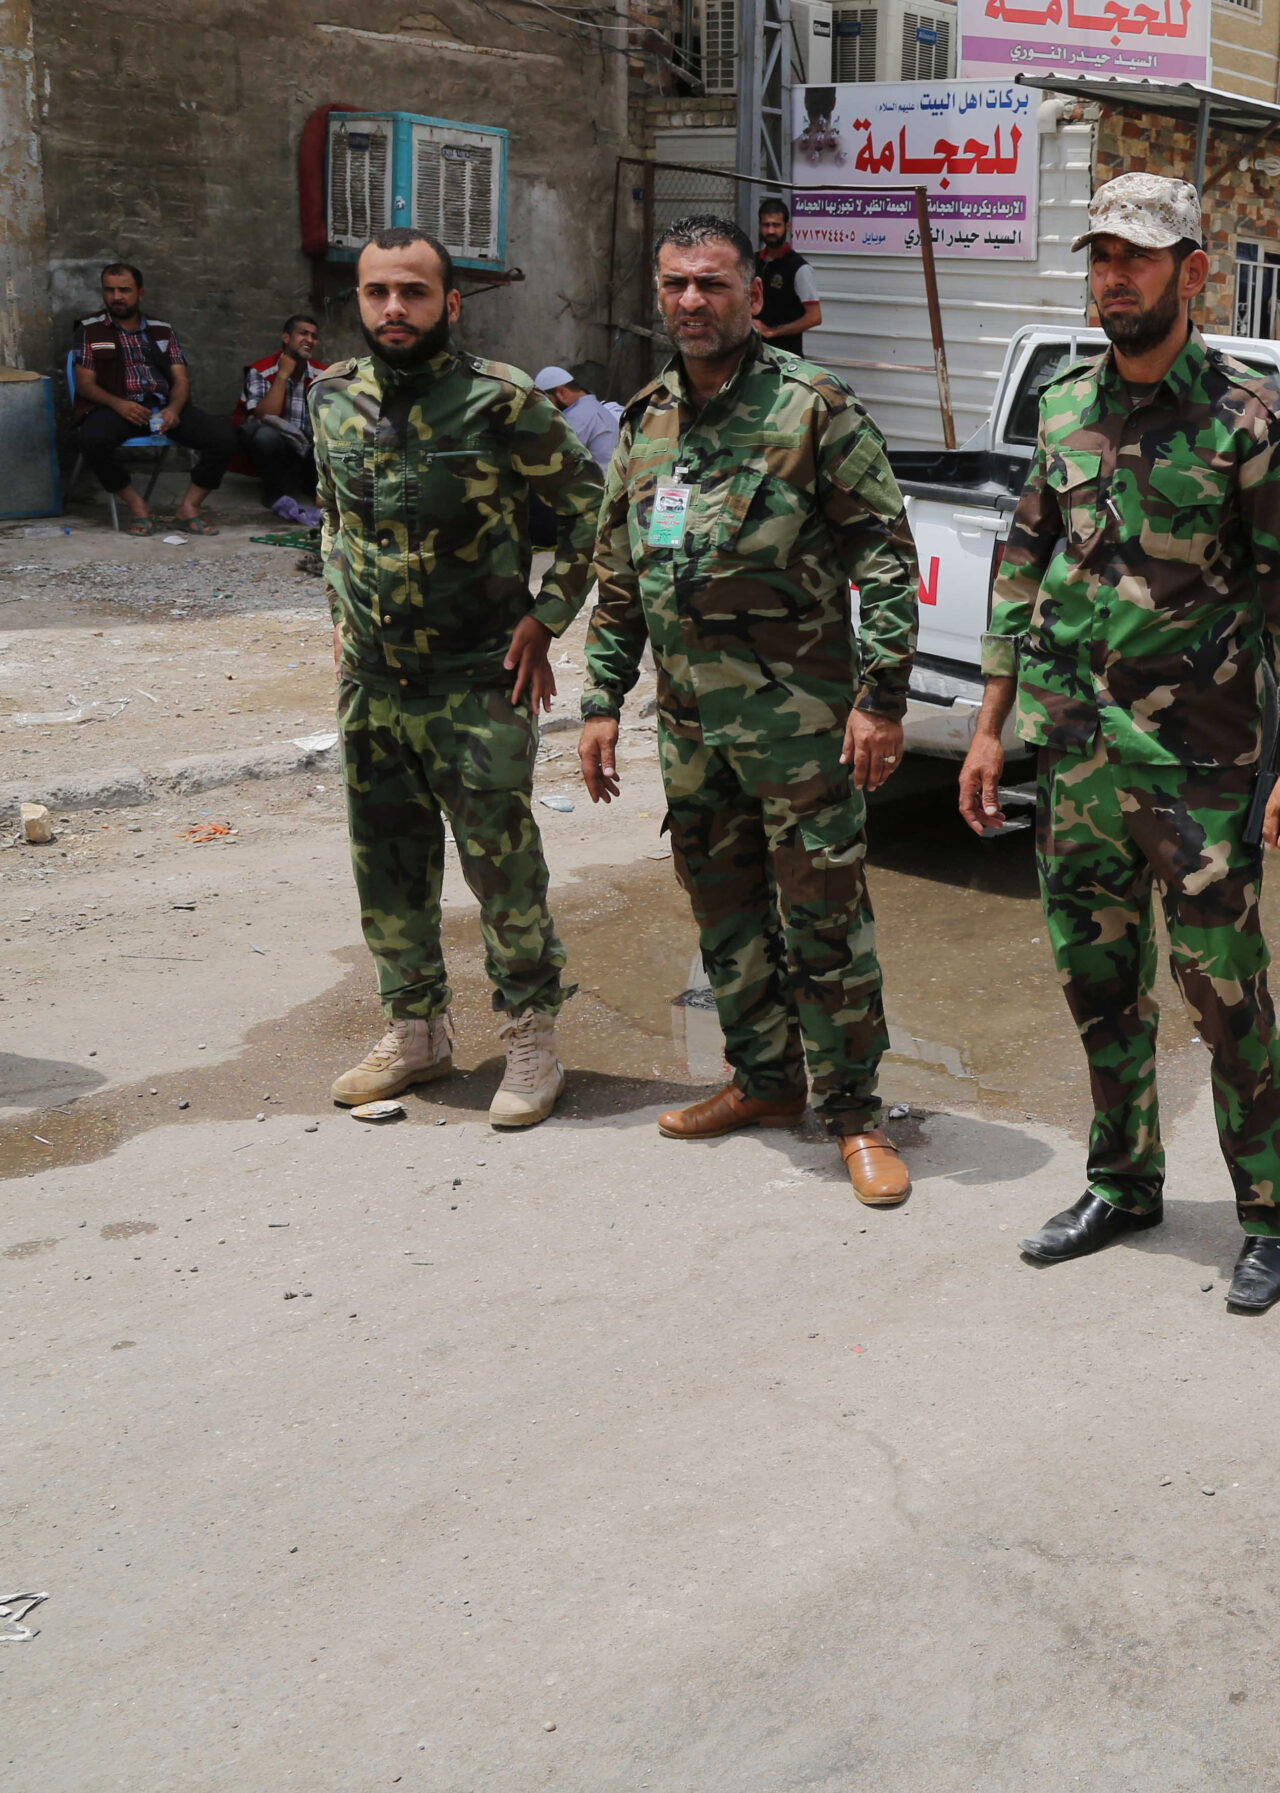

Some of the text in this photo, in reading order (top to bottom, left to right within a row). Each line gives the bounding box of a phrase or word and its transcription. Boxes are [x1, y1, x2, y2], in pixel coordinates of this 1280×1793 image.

[985, 0, 1191, 46] للحجام
[1010, 44, 1158, 71] السيد حيدر النوري
[920, 91, 956, 116] البيت
[958, 91, 982, 115] اهل
[986, 88, 1029, 115] بركات
[854, 117, 1022, 190] للحجامة
[795, 197, 824, 214] الحجامة
[825, 199, 837, 216] بها
[856, 199, 863, 211] لا
[886, 198, 912, 215] الجمعة
[926, 198, 959, 216] الحجامة
[960, 200, 972, 218] بها
[861, 232, 886, 245] موبايل
[904, 227, 1022, 249] السيد حيدر النري
